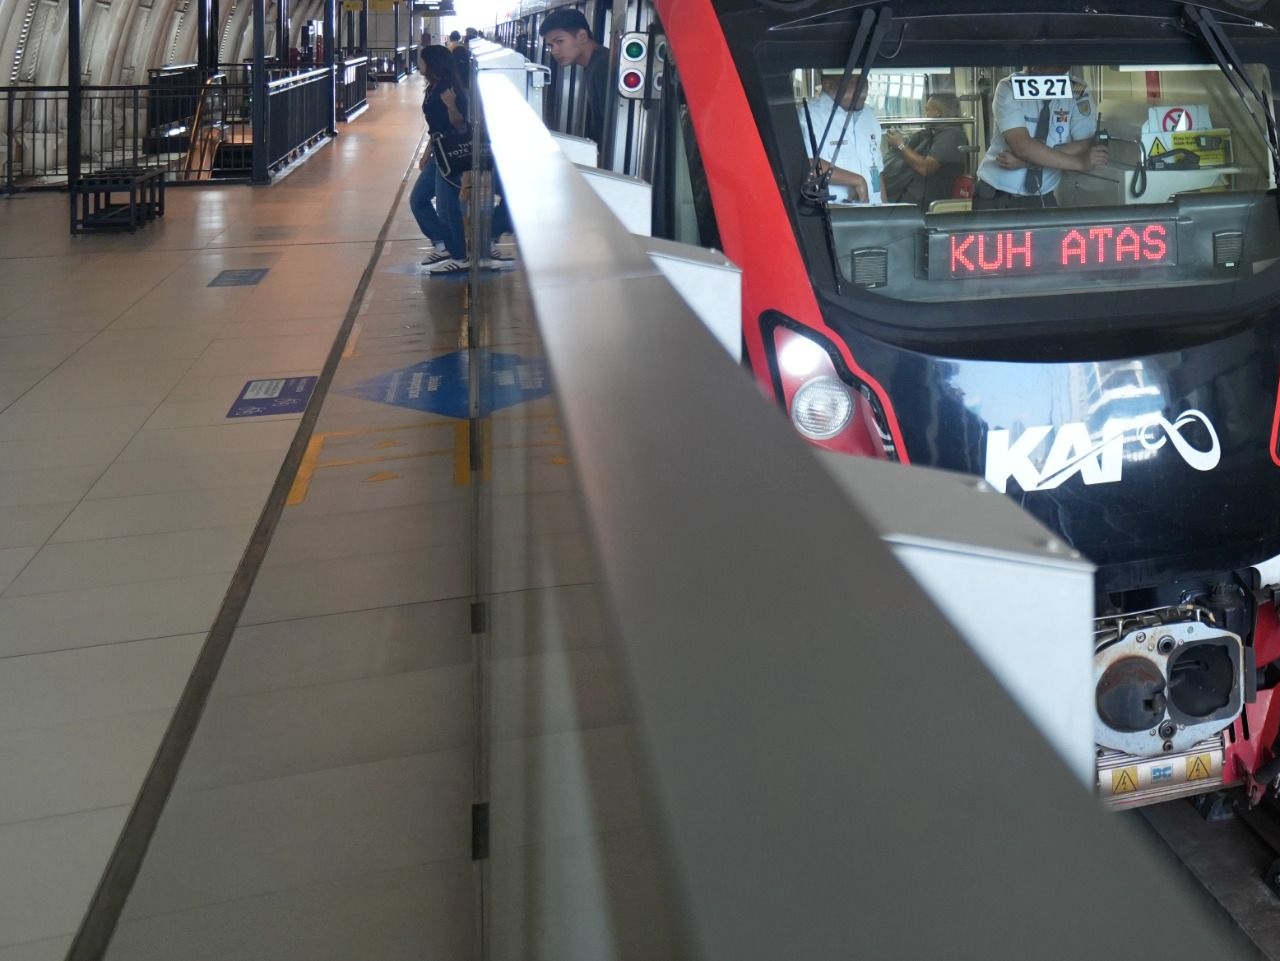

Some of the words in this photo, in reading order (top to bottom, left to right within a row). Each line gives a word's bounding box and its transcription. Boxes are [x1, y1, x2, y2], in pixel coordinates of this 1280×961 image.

[1015, 78, 1040, 97] TS
[1043, 78, 1067, 96] 27
[952, 231, 1033, 272] KUH
[1062, 224, 1166, 265] ATAS
[985, 420, 1124, 494] KAI
